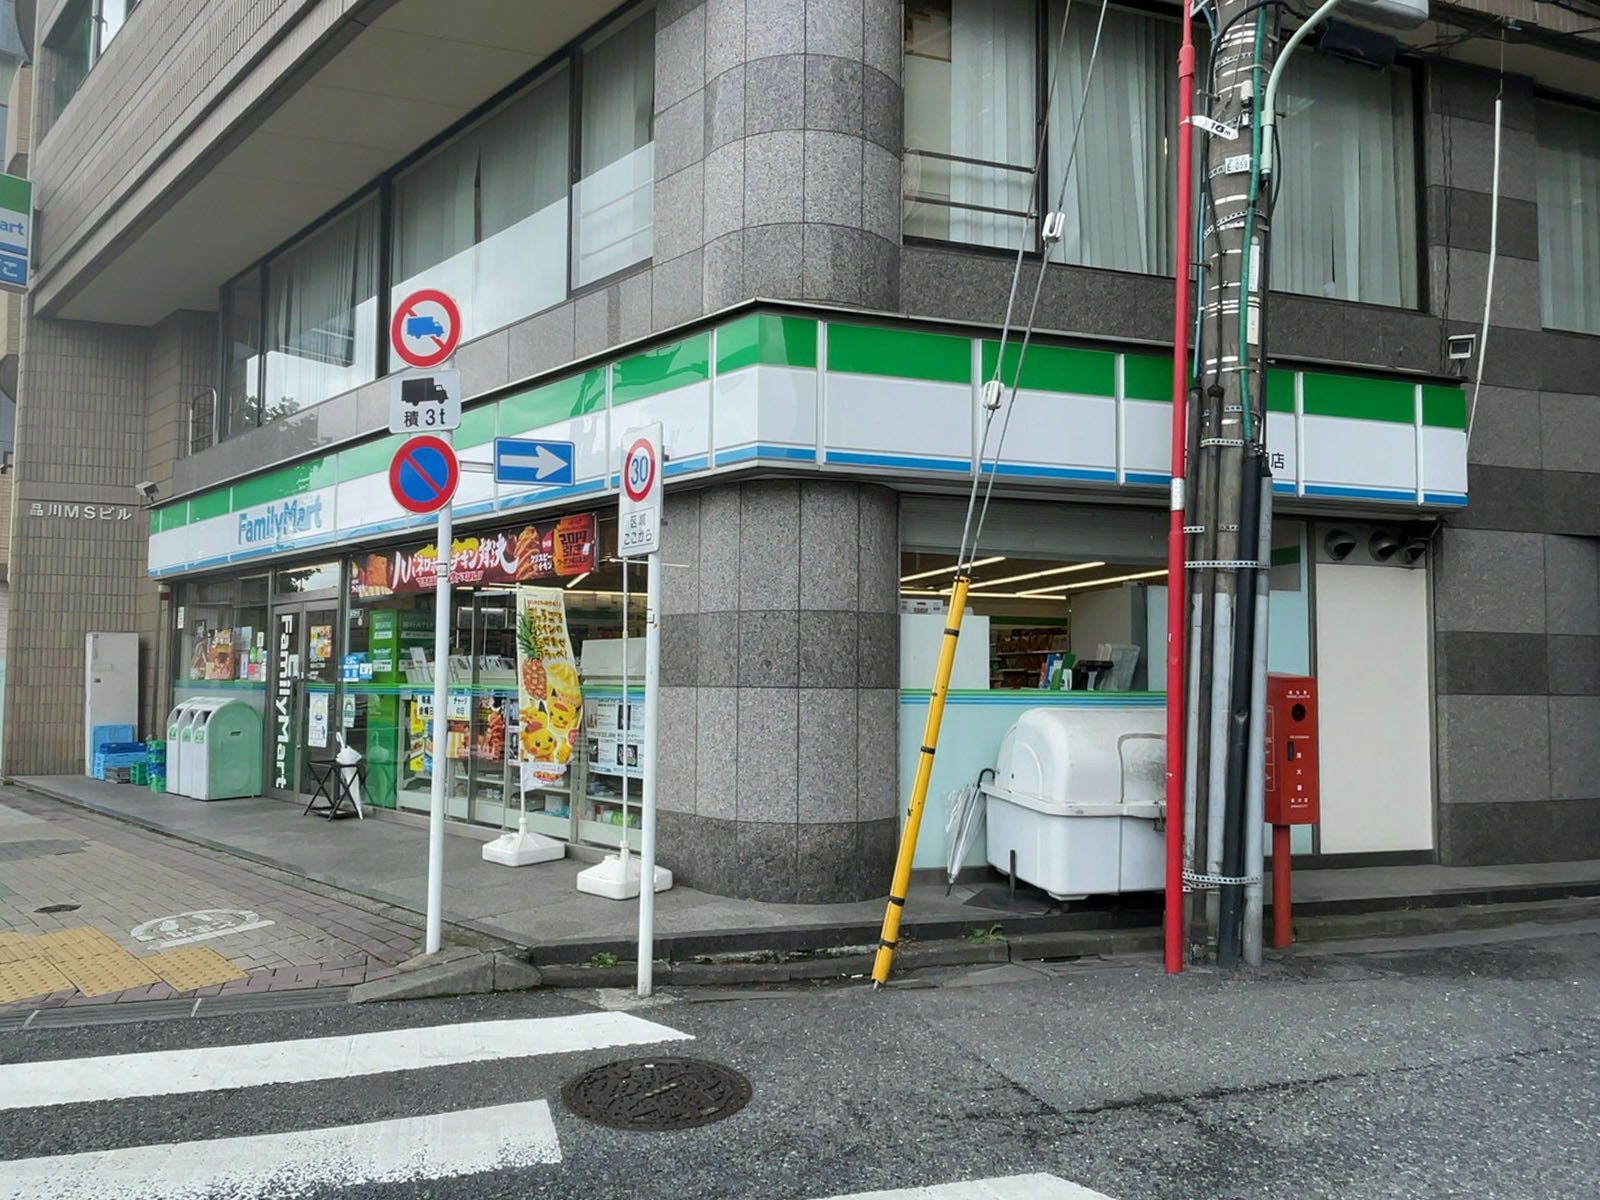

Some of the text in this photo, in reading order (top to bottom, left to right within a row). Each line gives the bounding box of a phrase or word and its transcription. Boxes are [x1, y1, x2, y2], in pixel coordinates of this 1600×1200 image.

[631, 455, 649, 485] 30
[238, 495, 322, 545] FamilyMart
[623, 529, 653, 546] ここから
[275, 614, 293, 789] FamilyMart
